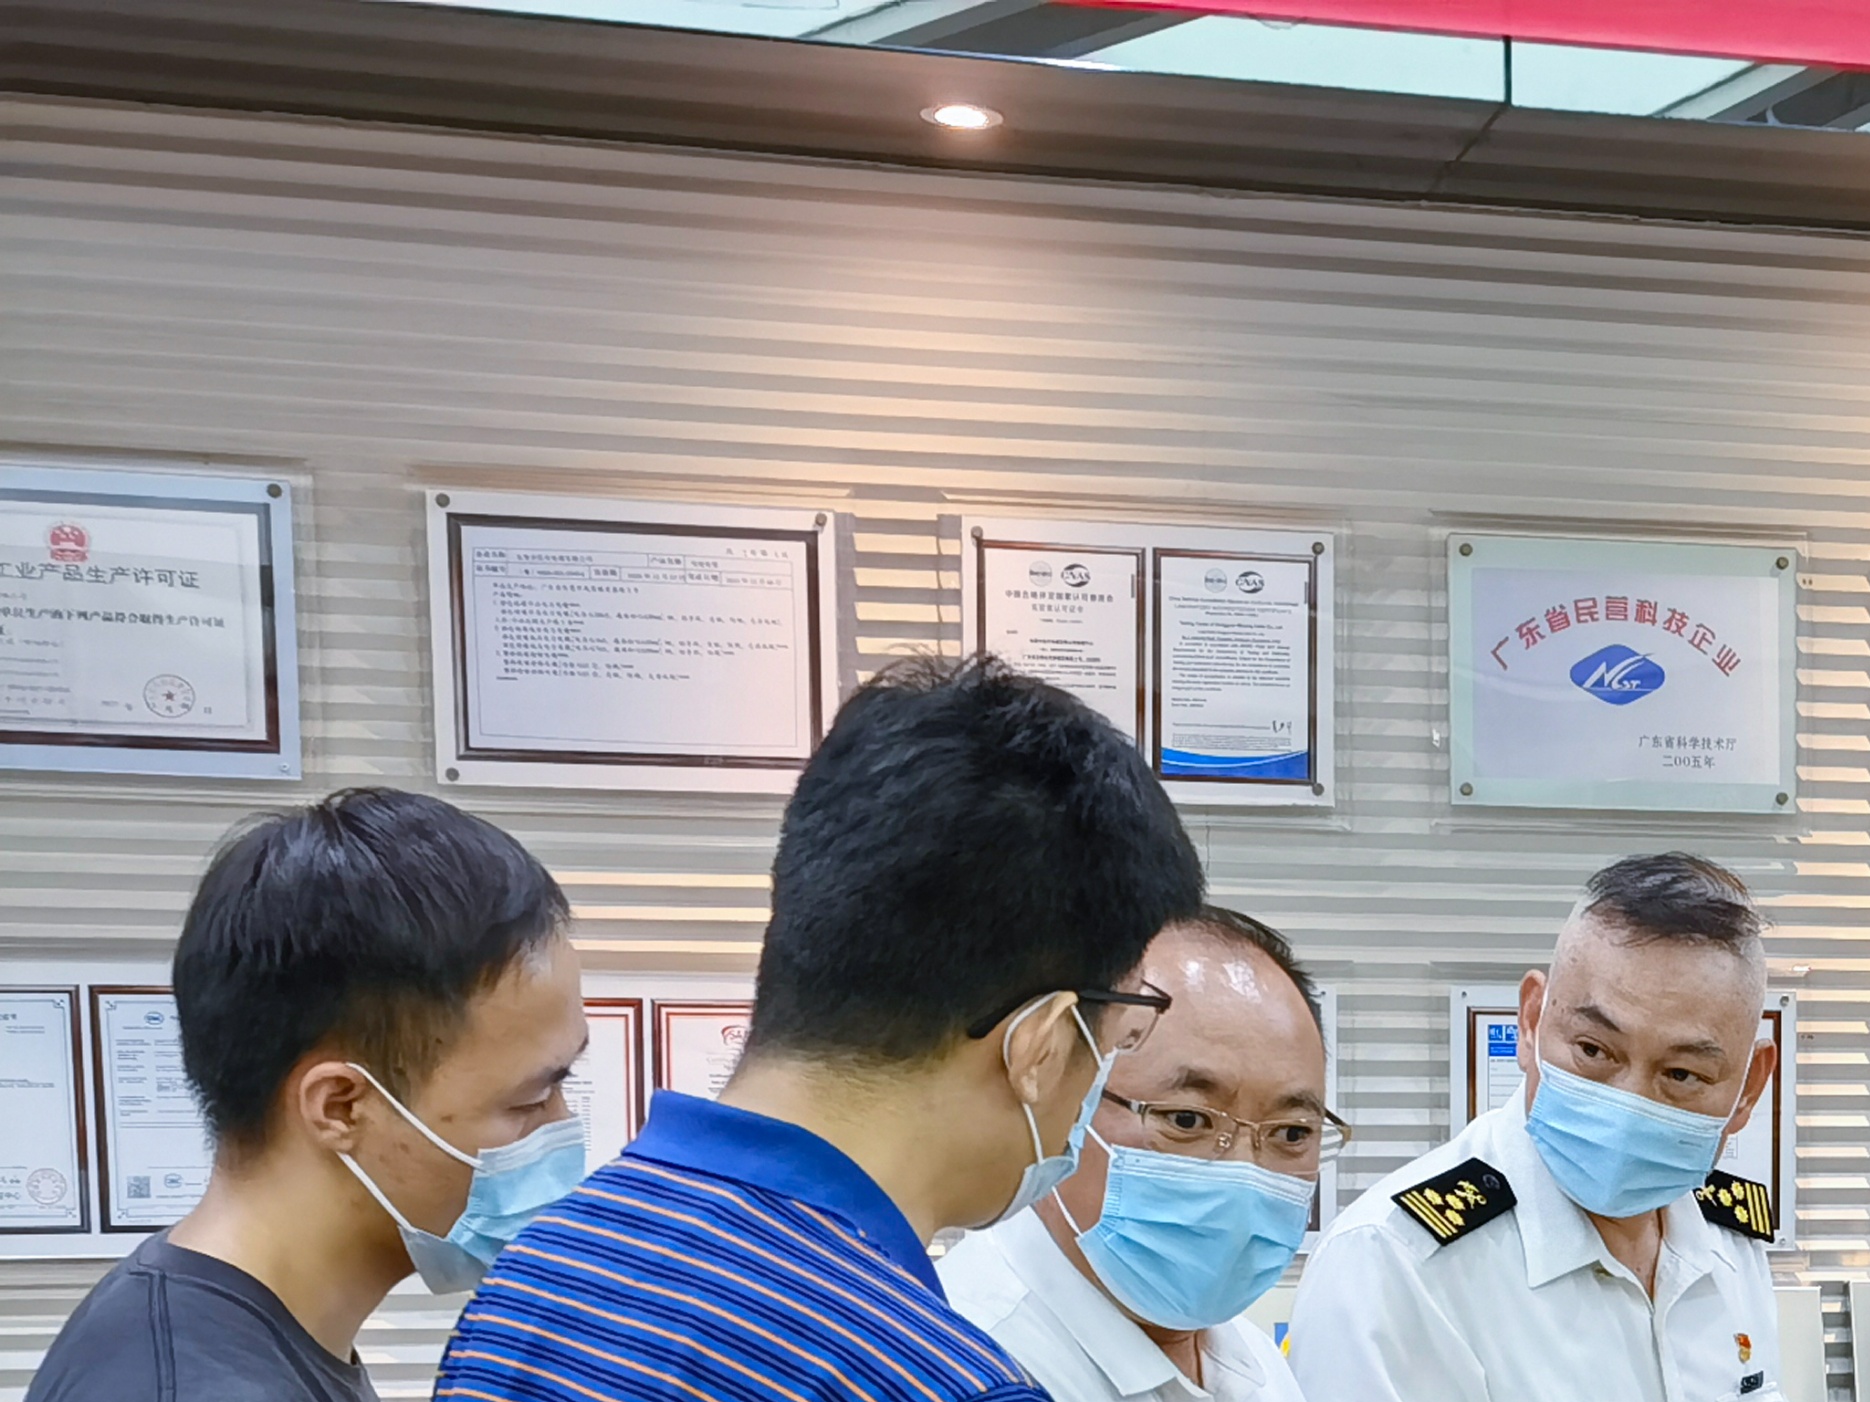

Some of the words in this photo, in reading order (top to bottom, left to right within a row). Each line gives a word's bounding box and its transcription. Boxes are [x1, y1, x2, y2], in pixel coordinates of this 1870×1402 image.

[1490, 595, 1741, 677] 广东省民营科技企业
[1638, 735, 1737, 751] 广东省科学技术厅
